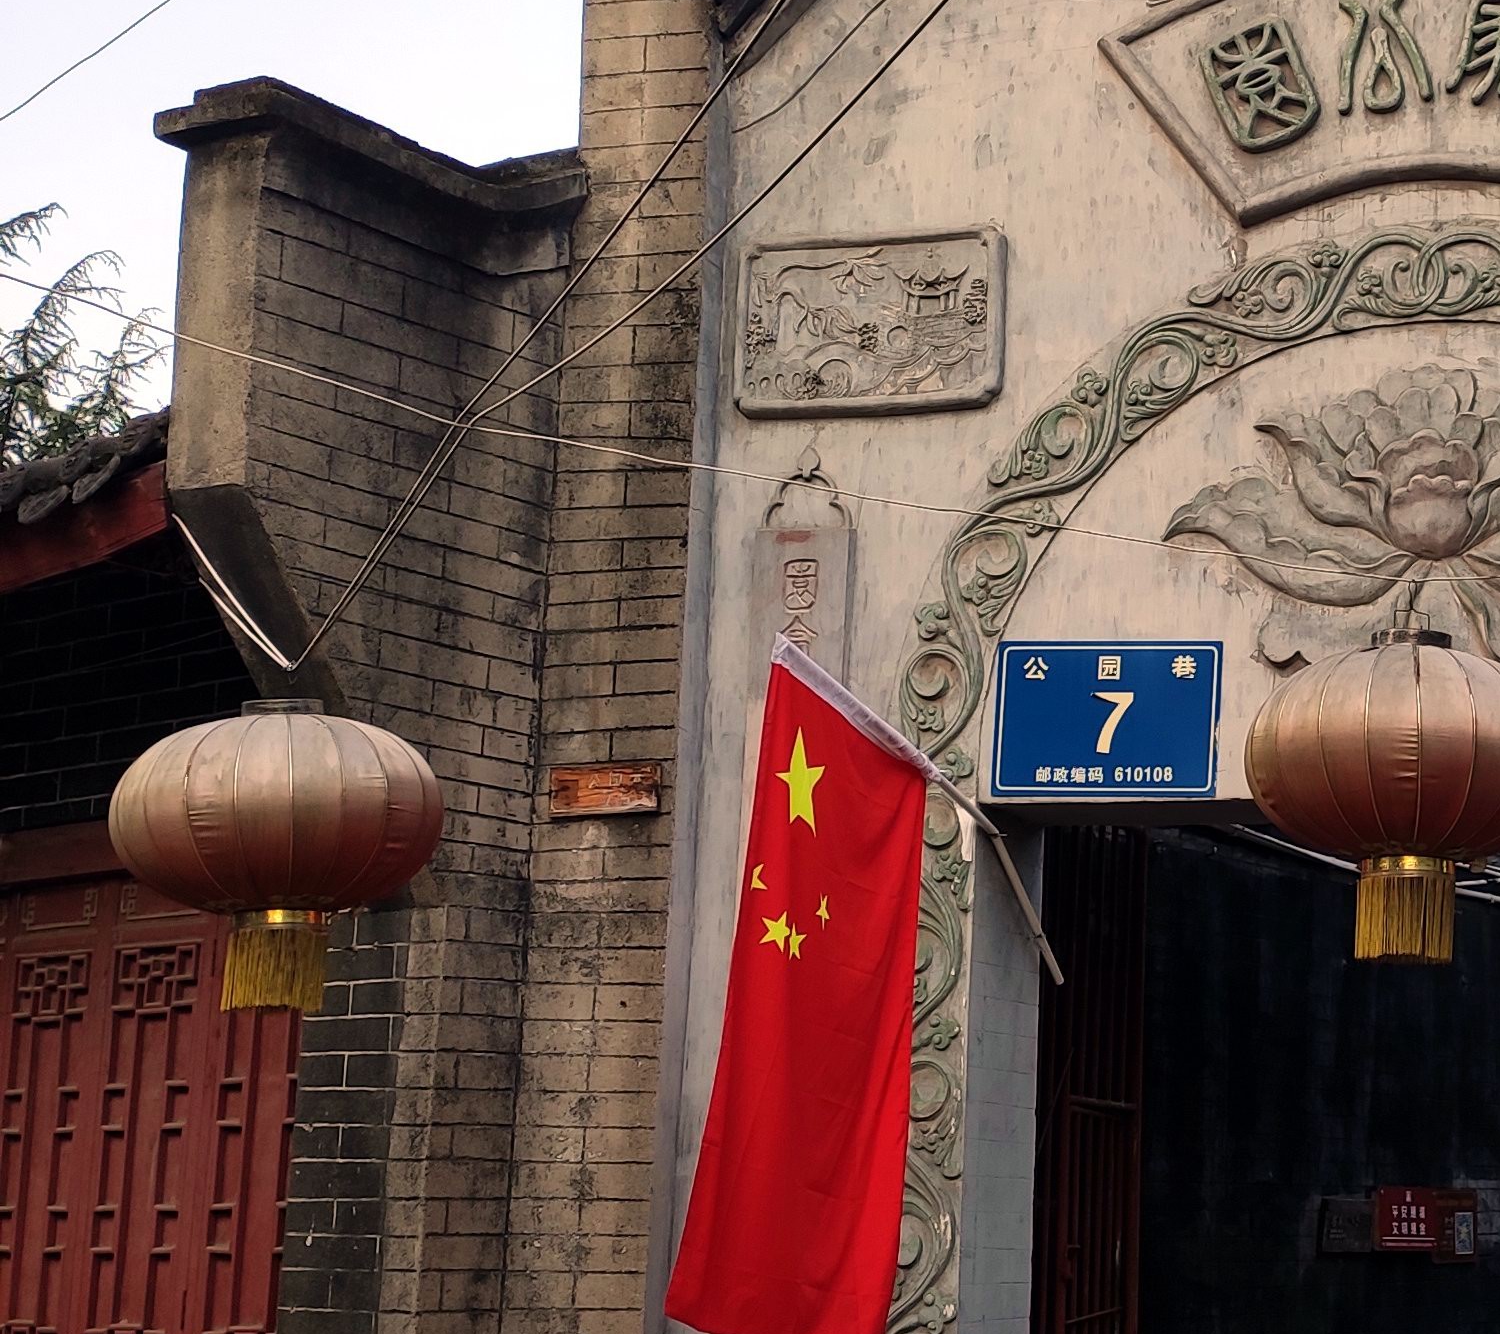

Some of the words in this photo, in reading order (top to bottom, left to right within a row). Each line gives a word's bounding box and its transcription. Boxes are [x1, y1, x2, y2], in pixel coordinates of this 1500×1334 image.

[1023, 655, 1197, 680] 公园巷
[1090, 692, 1134, 754] 7
[1035, 766, 1104, 784] 邮政编码
[1114, 766, 1173, 782] 610108
